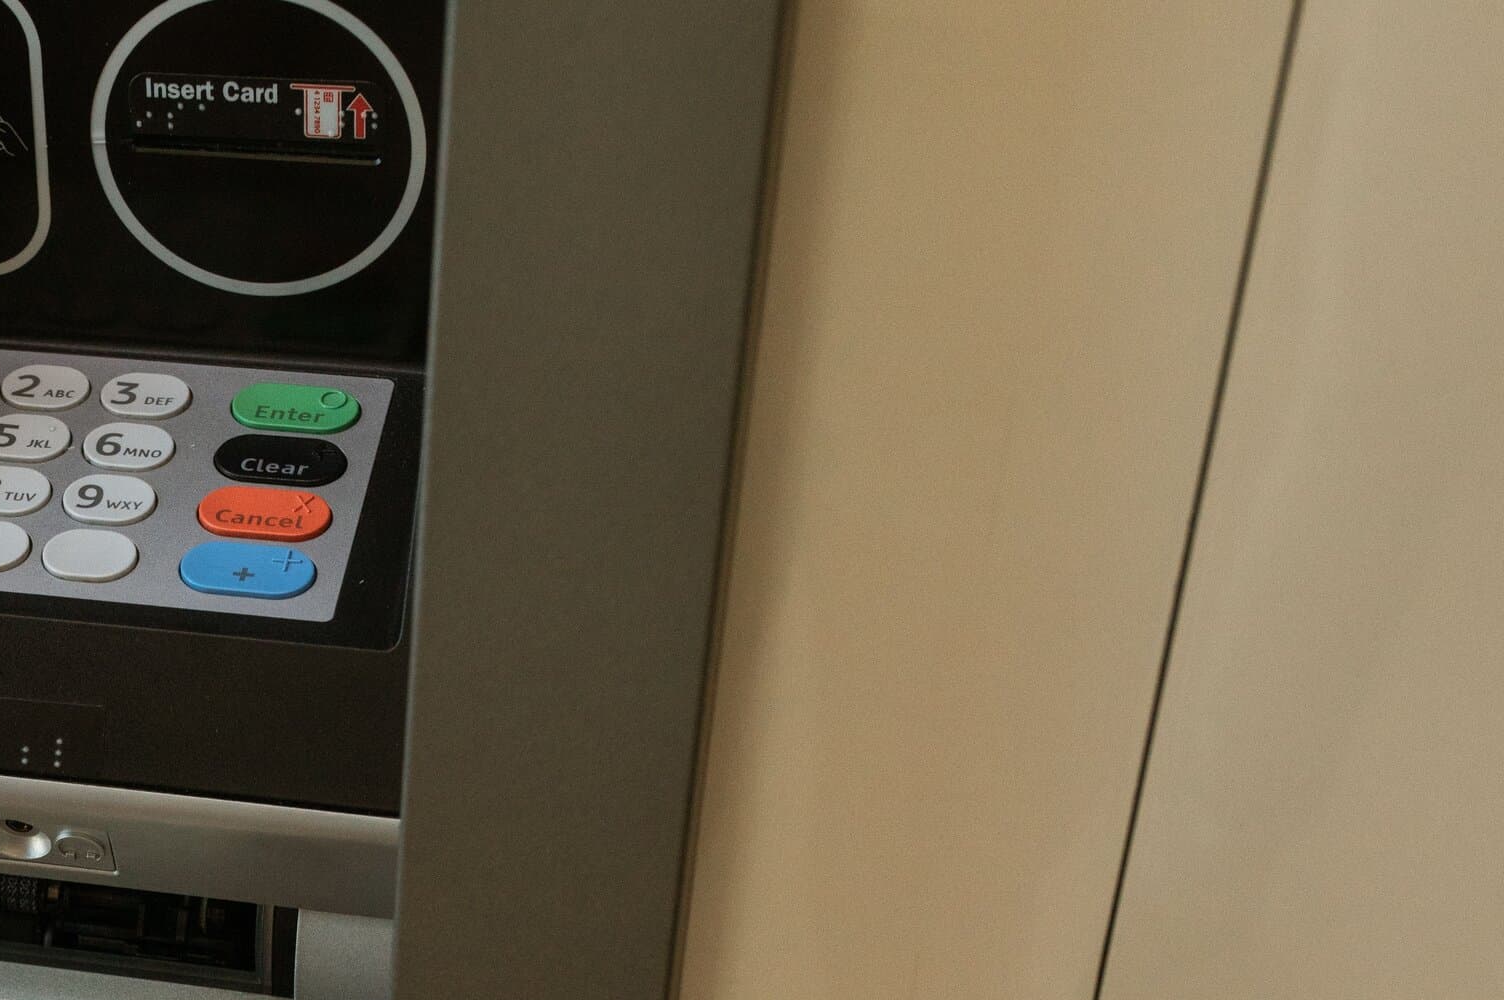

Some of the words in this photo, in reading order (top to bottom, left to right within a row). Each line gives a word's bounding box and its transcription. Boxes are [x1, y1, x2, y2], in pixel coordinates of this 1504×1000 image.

[146, 77, 214, 101] Insert
[222, 81, 278, 104] Card
[11, 374, 41, 398] 2
[43, 389, 76, 399] ABC
[110, 381, 139, 405] 3
[144, 396, 174, 406] DEF
[255, 405, 326, 424] Enter
[26, 439, 52, 448] JKL
[96, 432, 124, 456] 6
[122, 448, 162, 459] MNO
[240, 457, 309, 476] Clear
[4, 491, 37, 502] TUV
[76, 484, 104, 509] 9
[105, 500, 143, 510] WXY
[215, 508, 304, 529] Cancel
